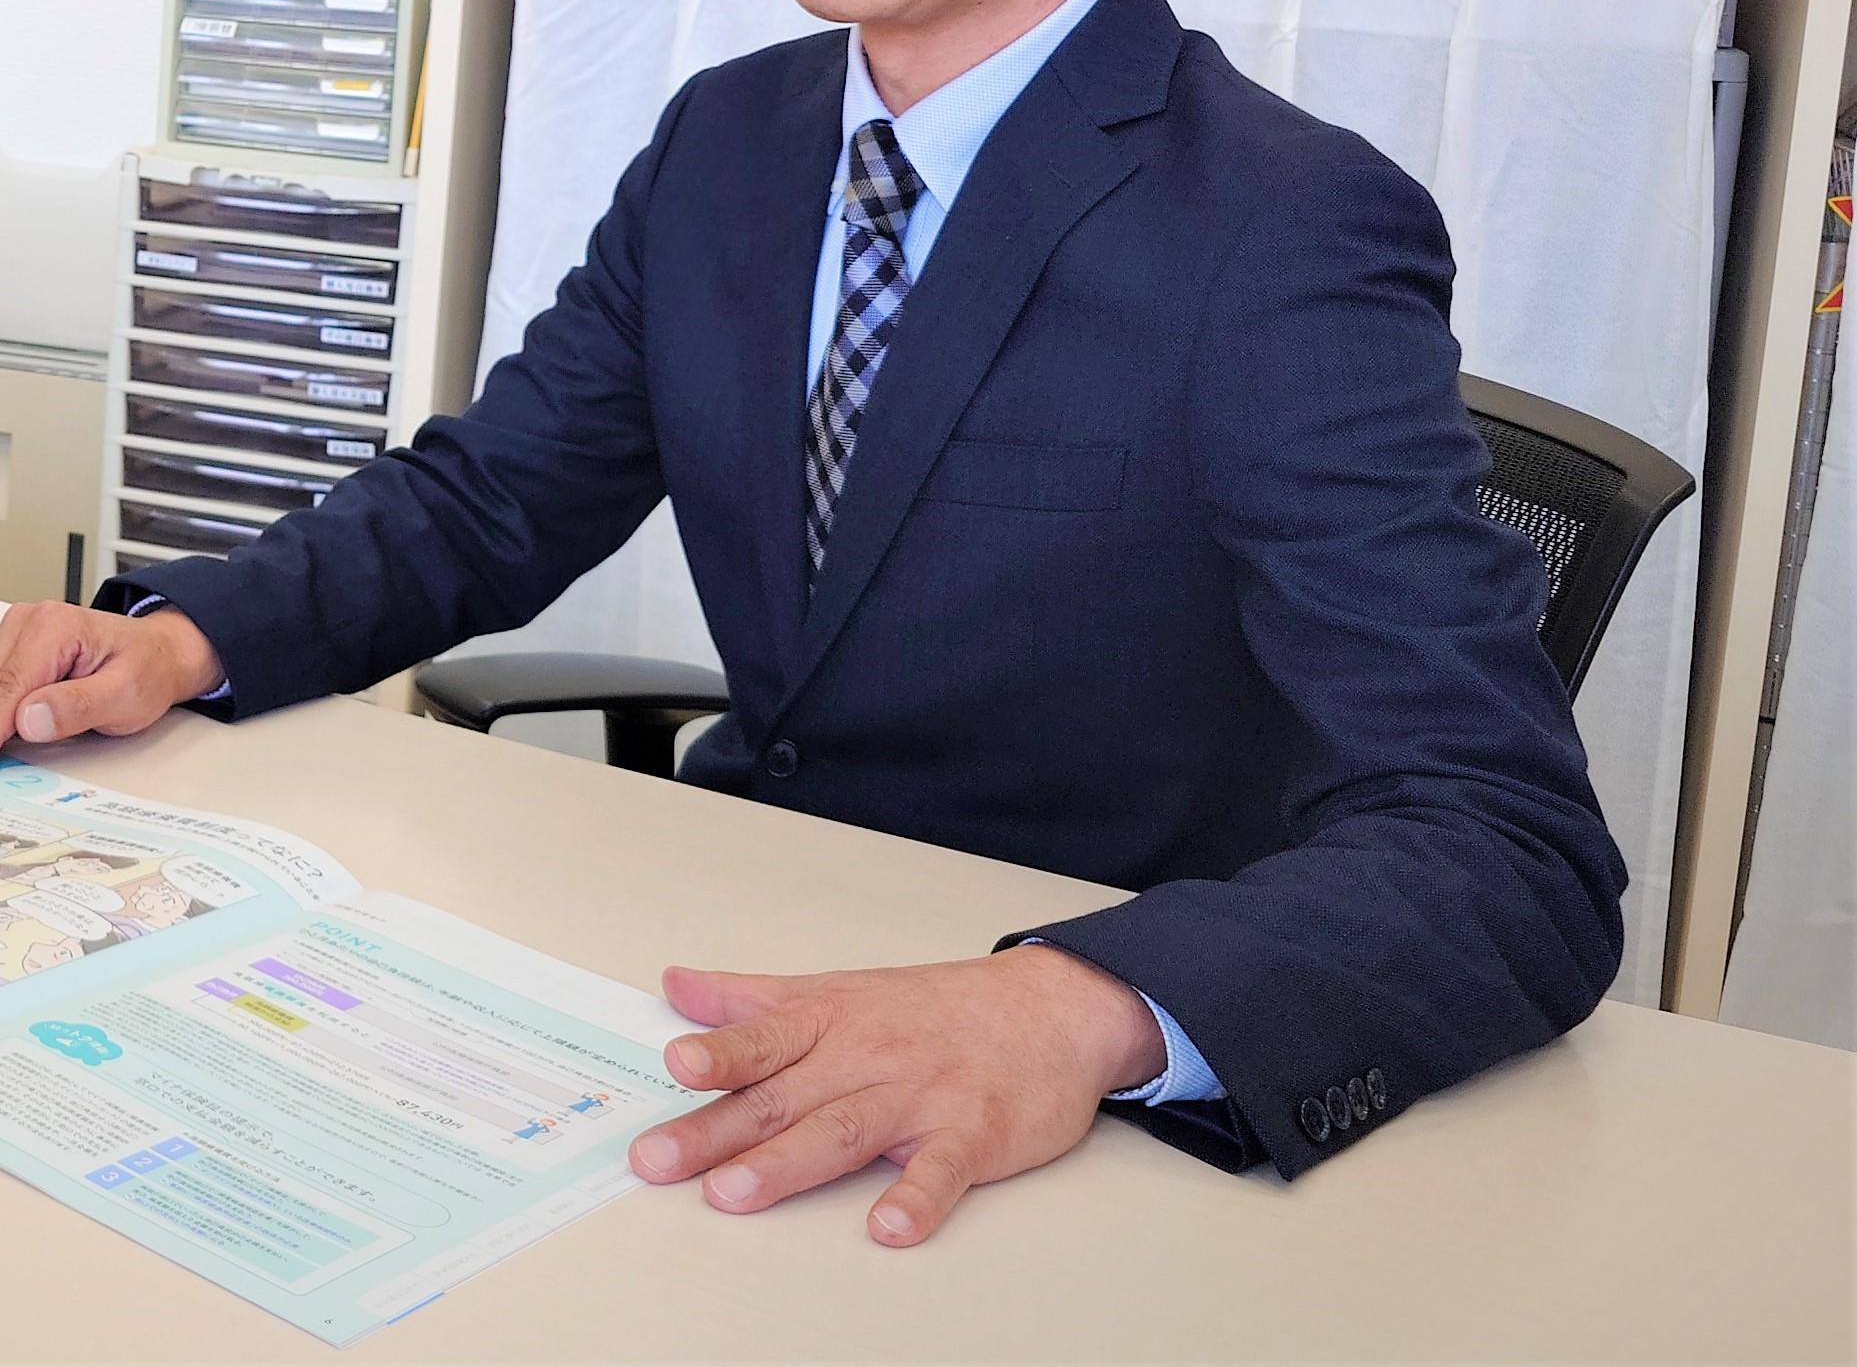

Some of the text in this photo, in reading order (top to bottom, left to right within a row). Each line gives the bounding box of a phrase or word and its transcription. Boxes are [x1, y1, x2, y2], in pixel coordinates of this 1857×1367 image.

[308, 920, 384, 953] POINT
[169, 1142, 183, 1154] 1
[137, 1156, 154, 1169] 2
[101, 1170, 120, 1183] 3
